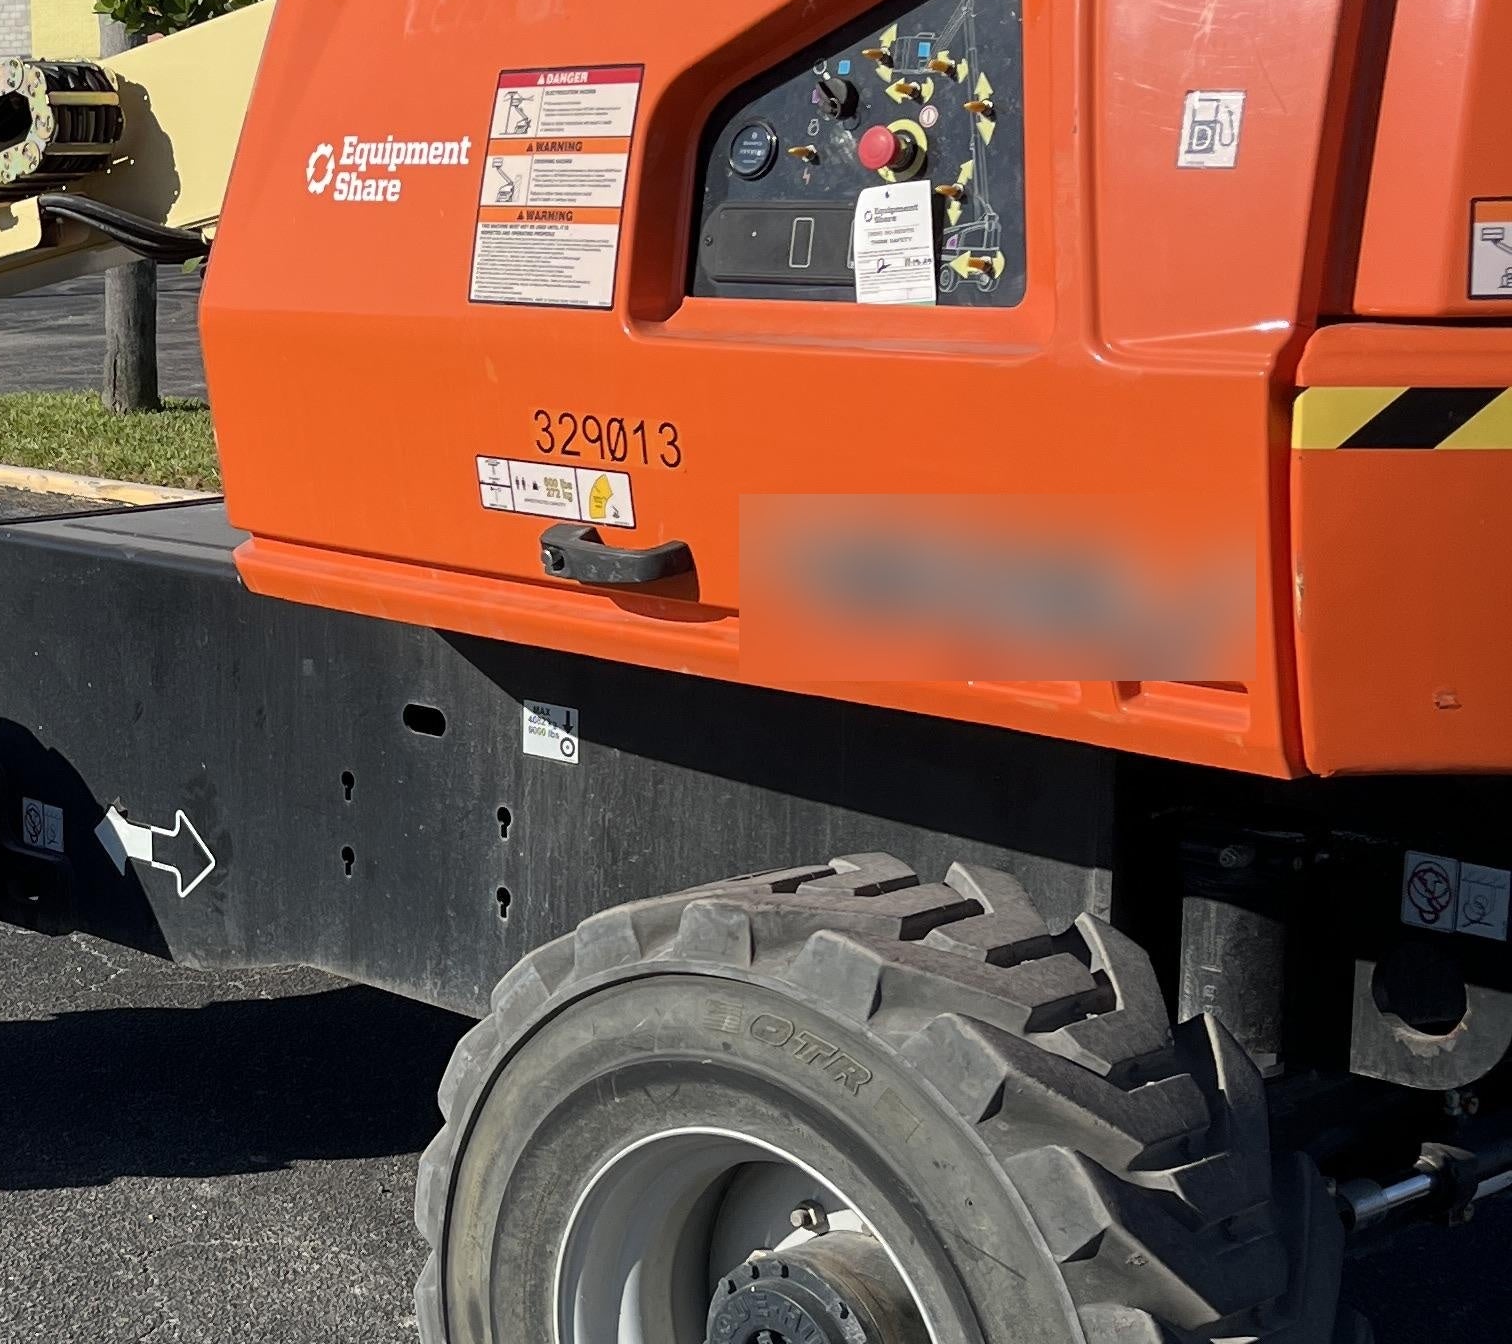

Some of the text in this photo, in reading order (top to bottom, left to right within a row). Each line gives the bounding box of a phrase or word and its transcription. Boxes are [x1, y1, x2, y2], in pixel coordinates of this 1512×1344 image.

[546, 72, 588, 84] DANGER
[339, 135, 472, 172] Equipment
[536, 141, 582, 152] WARNING
[333, 172, 401, 202] Share
[526, 210, 573, 222] WARNING
[534, 409, 682, 468] 329013
[532, 705, 550, 716] MAX
[750, 1013, 873, 1097] OTR
